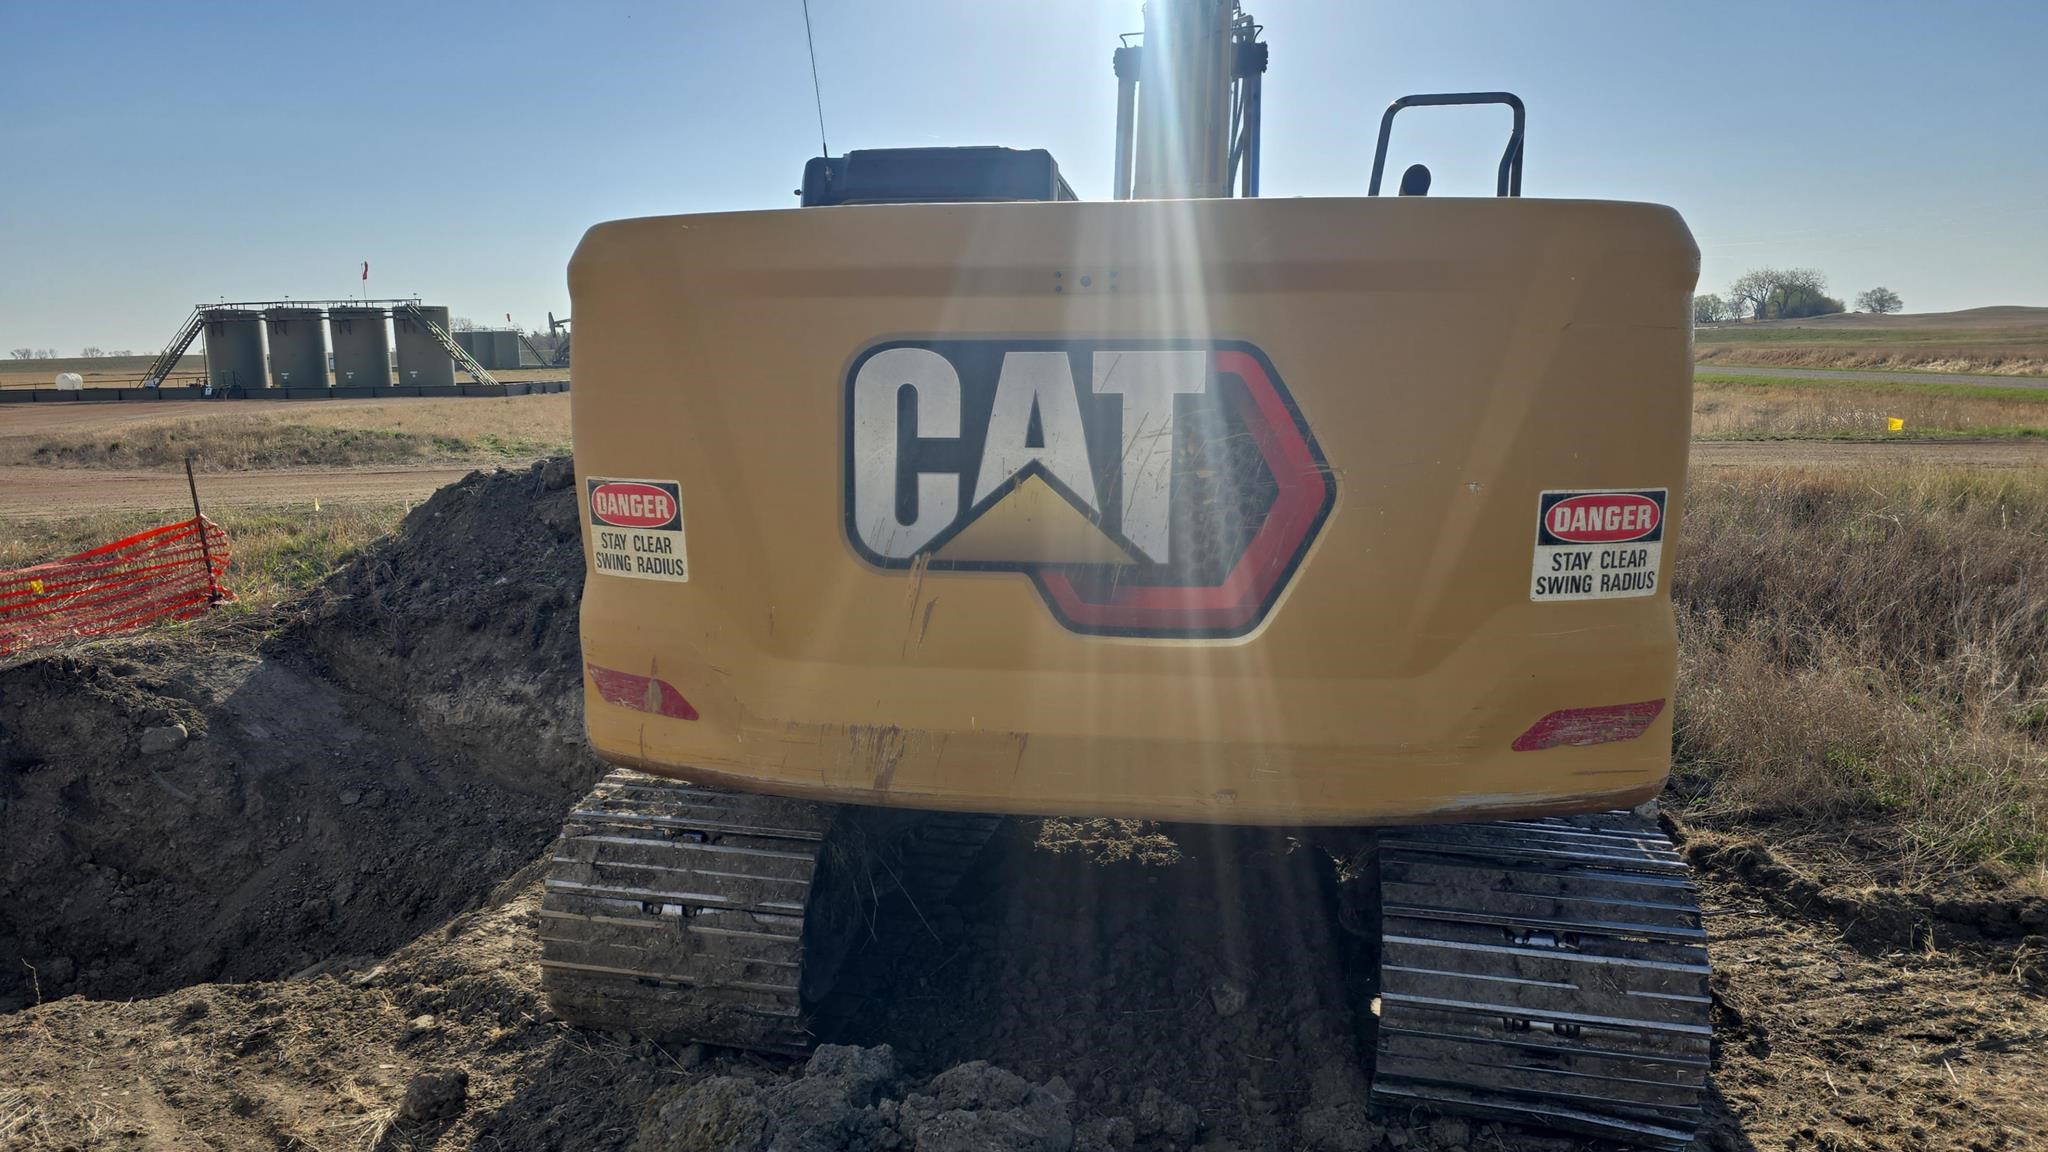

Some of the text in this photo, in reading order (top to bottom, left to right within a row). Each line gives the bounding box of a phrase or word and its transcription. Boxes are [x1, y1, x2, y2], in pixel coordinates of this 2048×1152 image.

[853, 347, 1207, 566] CAT
[596, 492, 670, 519] DANGER
[1554, 504, 1652, 533] DANGER
[600, 532, 672, 554] STAY CLEAR
[596, 551, 684, 577] SWING RADIUS
[1551, 549, 1648, 572] STAY CLEAR
[1535, 571, 1656, 596] SWING RADIUS
